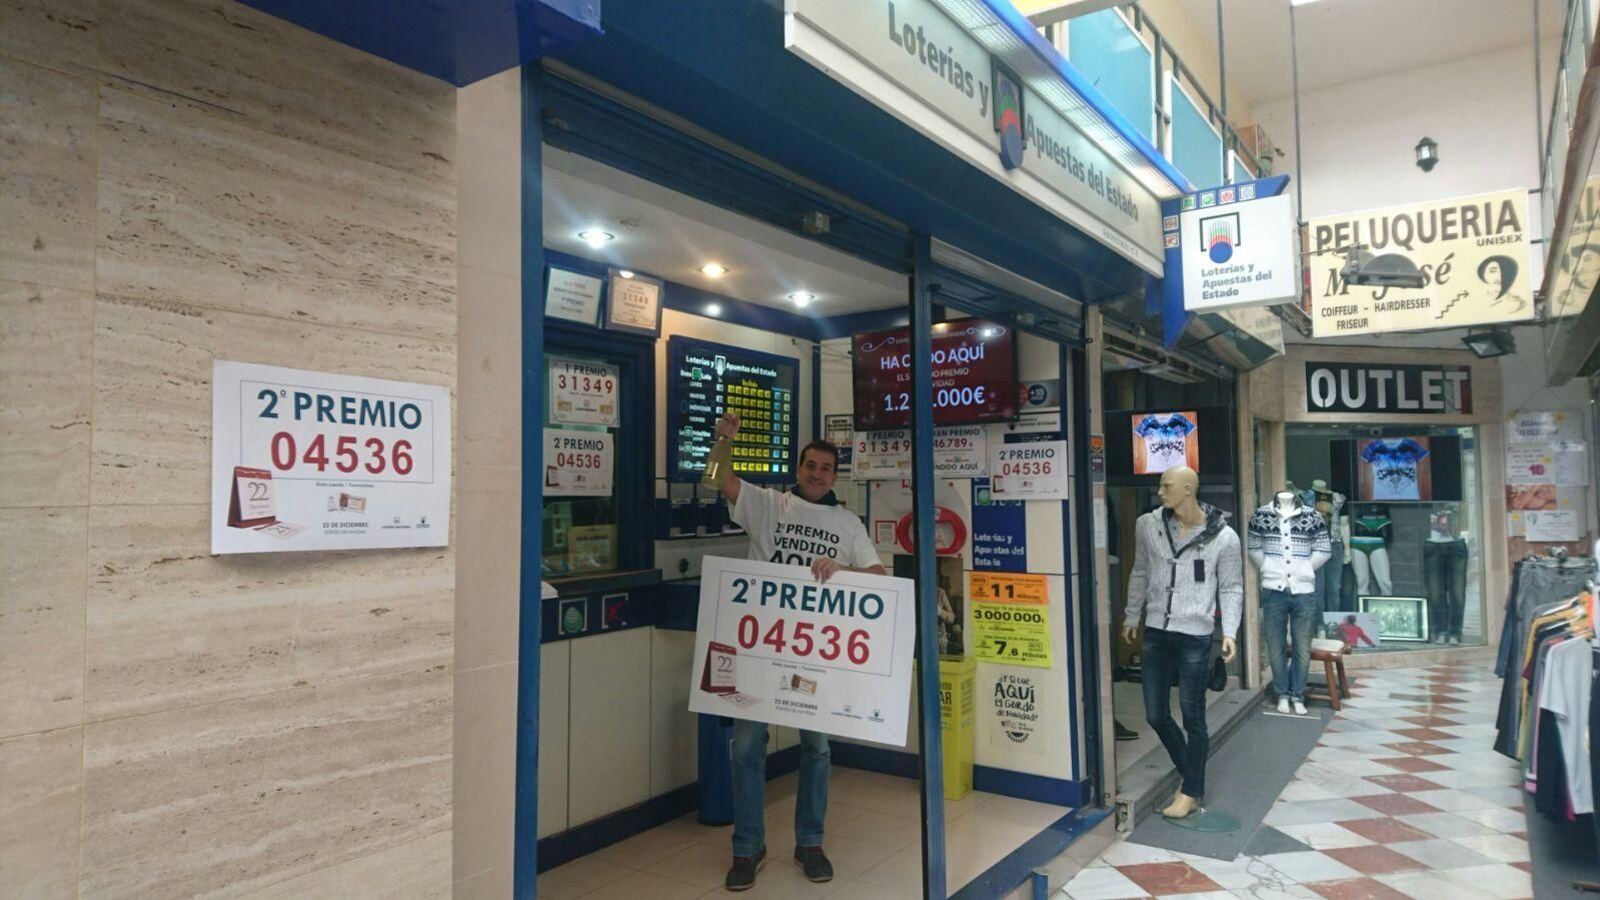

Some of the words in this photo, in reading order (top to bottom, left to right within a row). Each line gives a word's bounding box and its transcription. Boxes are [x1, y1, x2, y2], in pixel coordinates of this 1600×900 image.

[888, 1, 974, 99] Loterías
[978, 80, 989, 118] y
[1026, 113, 1085, 183] Apuestas
[1088, 163, 1104, 197] del
[1106, 176, 1138, 222] Estado
[1316, 199, 1521, 256] PELUQUERIA
[1476, 234, 1523, 247] UNISEX
[1201, 263, 1245, 277] Loterías
[1247, 262, 1255, 273] y
[1202, 275, 1252, 290] Apuestas
[1255, 270, 1272, 280] del
[1202, 288, 1239, 300] Estado
[1321, 304, 1358, 317] COIFFEUR
[1374, 298, 1431, 312] HAIRDRESSER
[1336, 318, 1369, 330] FRISEUR
[881, 357, 900, 370] HA
[948, 342, 985, 363] AQUÍ
[573, 364, 607, 377] PREMIO
[940, 367, 969, 378] PREMIO
[1311, 368, 1468, 409] OUTLET
[294, 391, 422, 430] PREMIO
[873, 430, 905, 440] PREMIO
[949, 428, 980, 436] PREMIO
[271, 431, 413, 475] 04536
[564, 438, 604, 451] PREMIO
[557, 452, 601, 469] 04536
[1010, 448, 1055, 460] PREMIO
[959, 461, 978, 470] AQUÍ
[1003, 461, 1051, 476] 04536
[248, 482, 269, 502] 22
[786, 523, 840, 544] PREMIO
[773, 536, 838, 559] VENDIDO
[760, 580, 884, 620] PREMIO
[991, 583, 1014, 599] 11
[737, 614, 870, 665] 04536
[994, 682, 1035, 704] AQUÍ
[790, 700, 818, 710] DICIEMBRE
